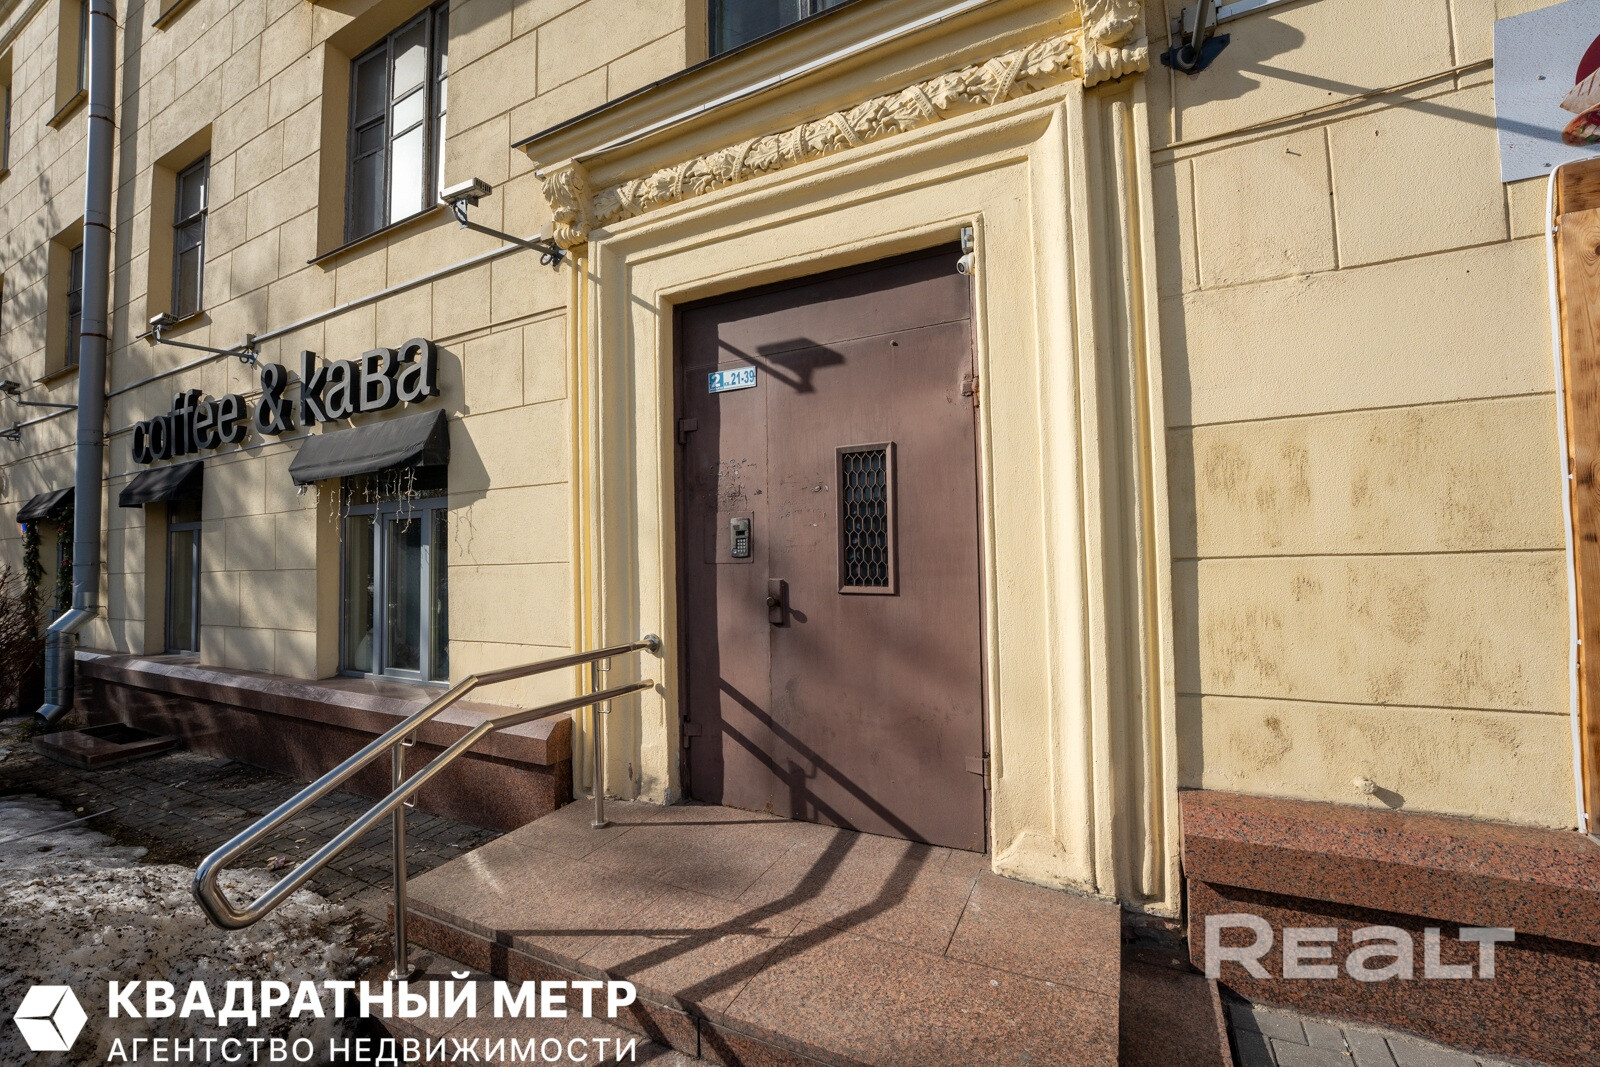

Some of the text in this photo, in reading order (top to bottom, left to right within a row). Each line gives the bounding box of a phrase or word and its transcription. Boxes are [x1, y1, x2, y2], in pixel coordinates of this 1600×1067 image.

[711, 373, 721, 387] 2
[731, 369, 755, 385] 21-39
[132, 389, 247, 464] coffee
[255, 363, 295, 436] &
